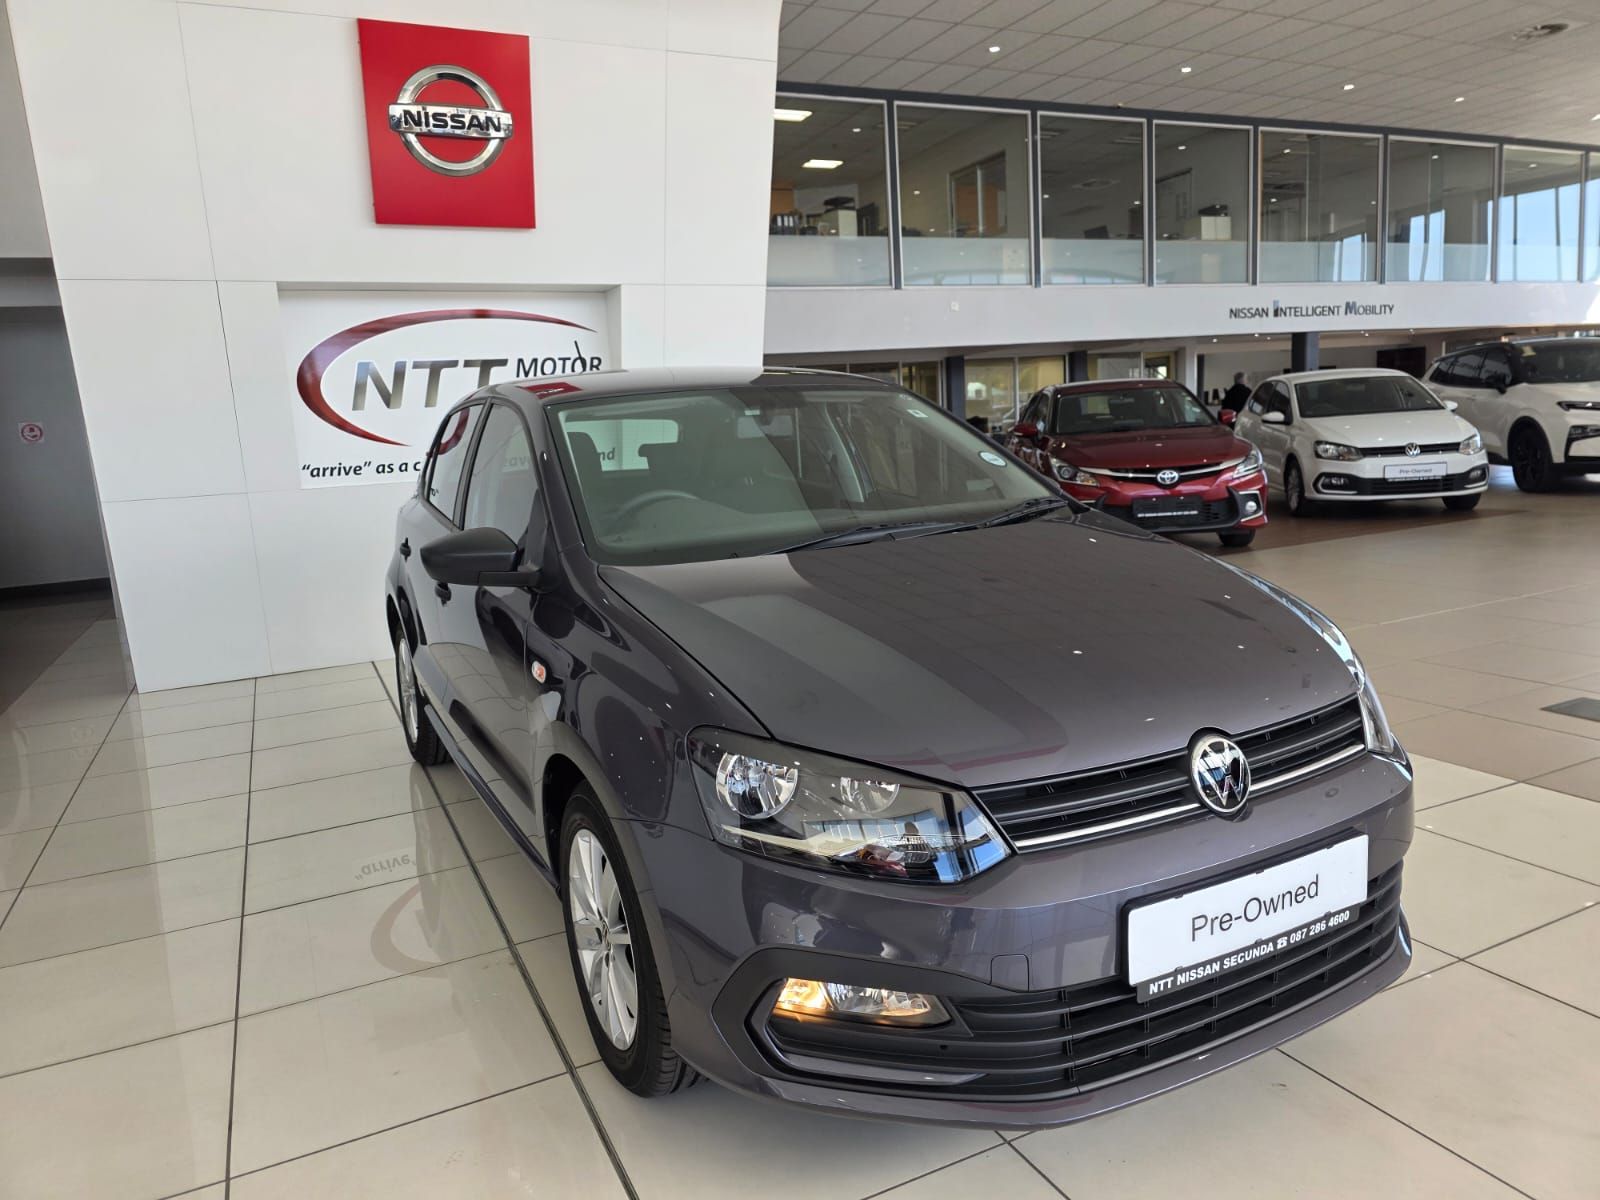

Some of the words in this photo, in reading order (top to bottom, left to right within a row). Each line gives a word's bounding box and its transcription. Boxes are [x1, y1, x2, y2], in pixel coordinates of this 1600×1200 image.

[402, 109, 501, 133] NISSAN
[1229, 307, 1269, 319] NISSAN
[1273, 300, 1342, 318] INTELLIGENT
[1344, 301, 1395, 316] MOBILITY
[515, 356, 602, 378] MOTOR
[351, 358, 509, 411] NTT
[375, 463, 395, 475] as
[398, 462, 409, 473] a
[1190, 873, 1319, 942] Pre-Owned
[1149, 977, 1174, 995] NTT
[1177, 962, 1220, 985] NISSAN
[1223, 941, 1274, 969] SECUNDA
[1289, 929, 1307, 943] 087
[1309, 922, 1326, 936] 286
[1328, 910, 1350, 927] 4600
